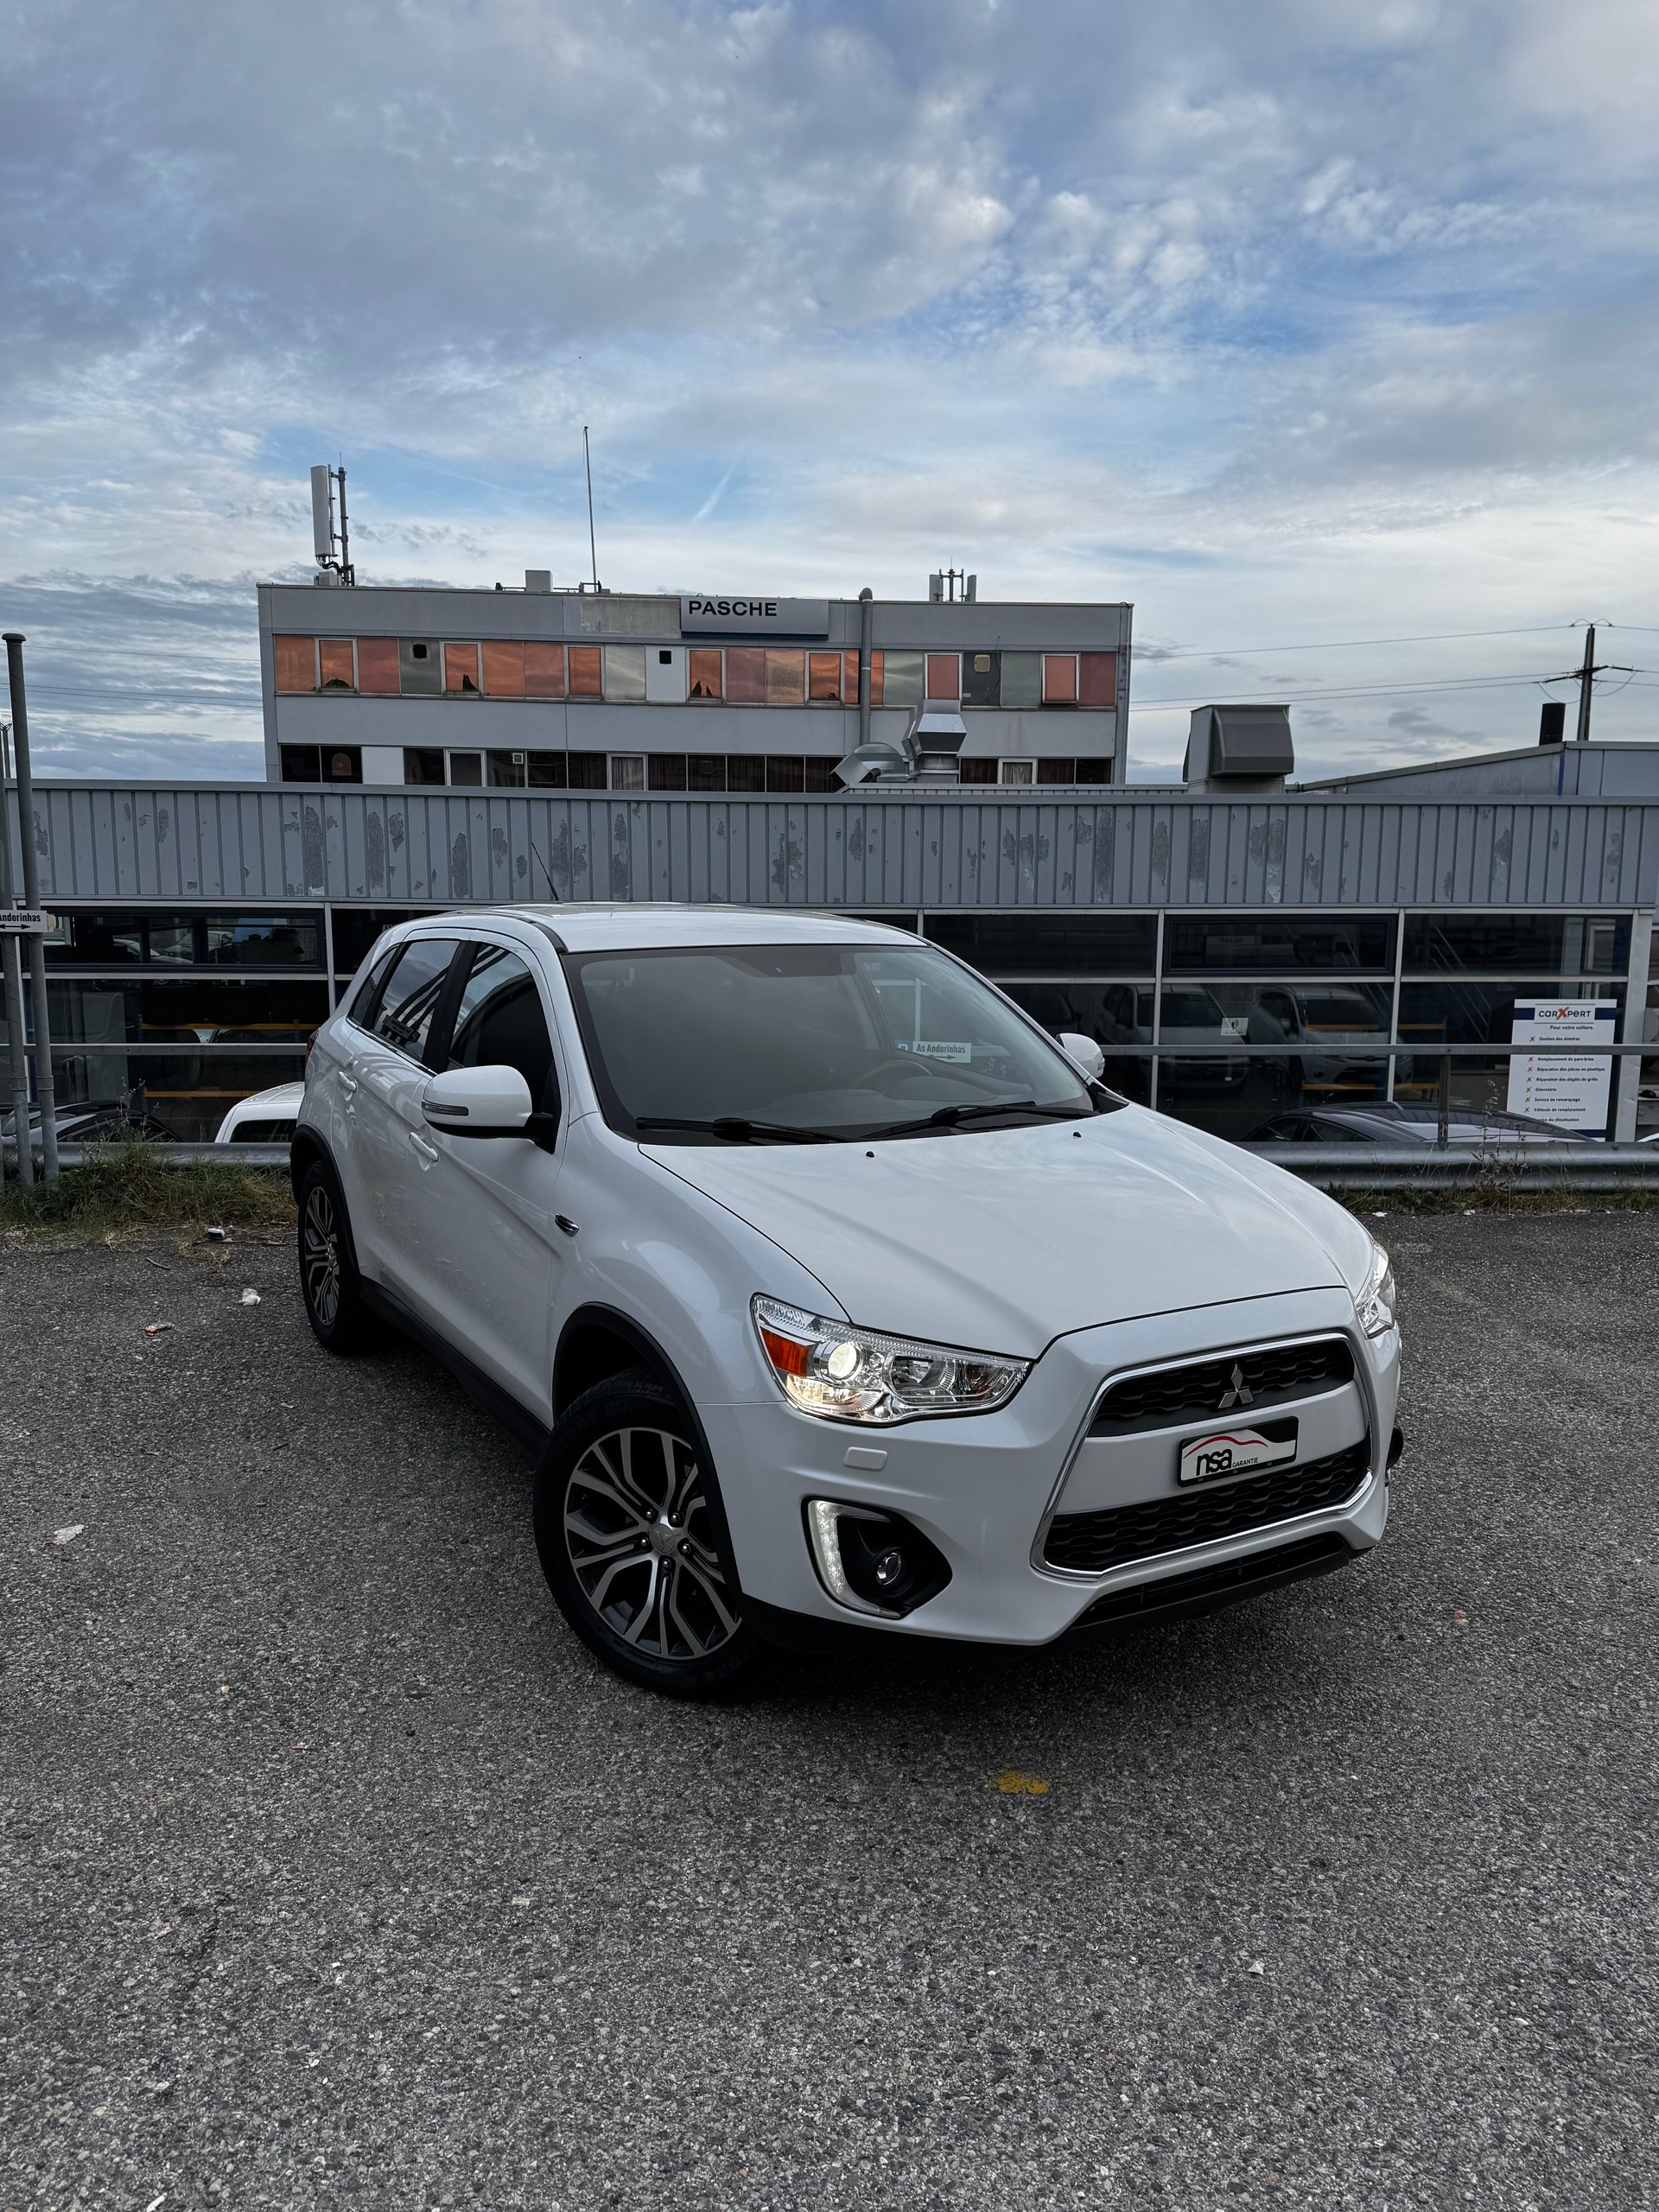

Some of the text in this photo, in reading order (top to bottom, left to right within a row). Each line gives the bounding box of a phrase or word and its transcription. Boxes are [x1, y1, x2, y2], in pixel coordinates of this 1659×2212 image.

[689, 600, 778, 617] PASCHE
[917, 1044, 925, 1052] As
[927, 1044, 966, 1053] Andorinhas
[1196, 1449, 1258, 1476] nsa GARANTIE
